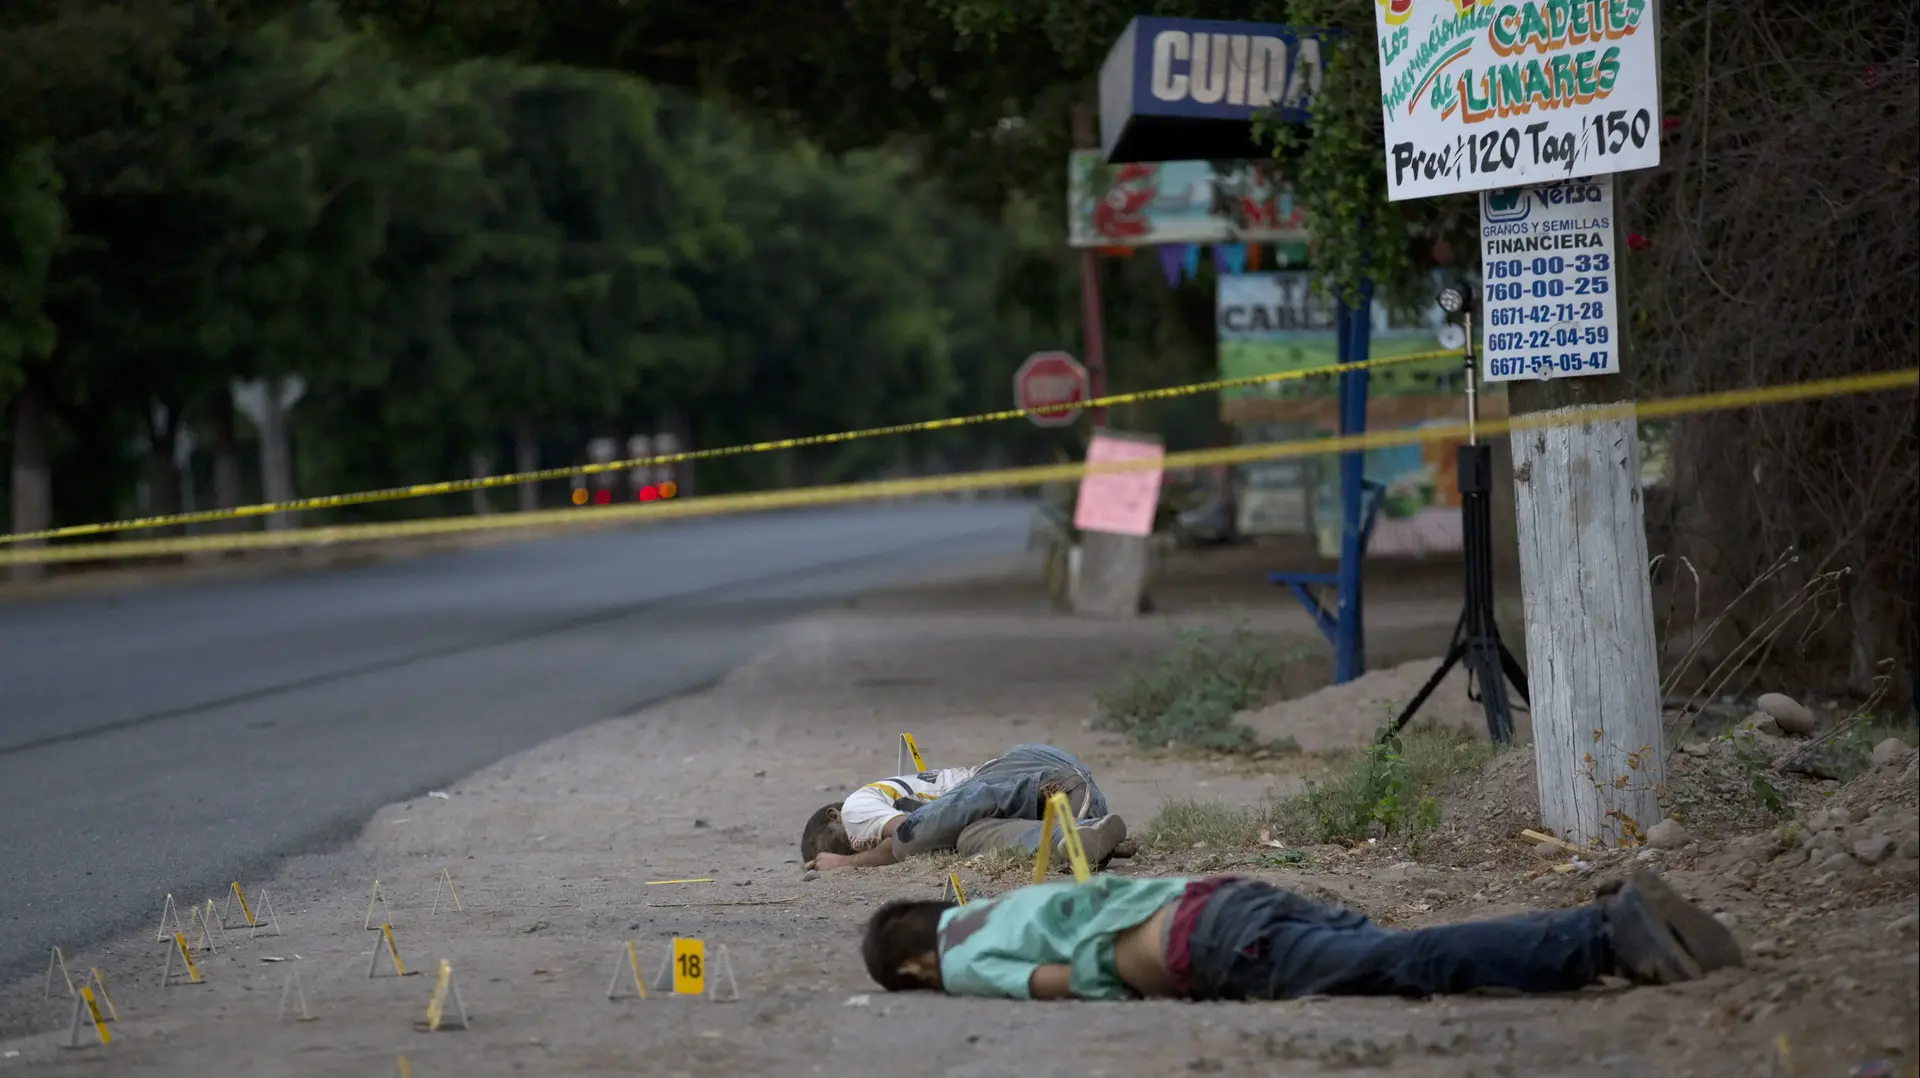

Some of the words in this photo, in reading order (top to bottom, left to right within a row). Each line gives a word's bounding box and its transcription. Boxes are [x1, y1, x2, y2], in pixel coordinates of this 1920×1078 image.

[1489, 0, 1646, 54] CADETES
[1381, 25, 1408, 67] Los
[1430, 73, 1452, 110] de
[1458, 46, 1621, 121] LINARES
[1483, 222, 1528, 237] GRANOS
[1531, 222, 1539, 233] Y
[1542, 218, 1609, 233] SEMILLAS
[1487, 232, 1603, 255] FINANCIERA
[1486, 253, 1609, 279] 760-00-33
[1486, 276, 1609, 302] 760-00-25
[1491, 301, 1603, 326] 6671-42-71-28
[1488, 326, 1609, 351] 6672-22-04-59
[1490, 351, 1608, 376] 6677-55-05-47
[677, 953, 702, 979] 18
